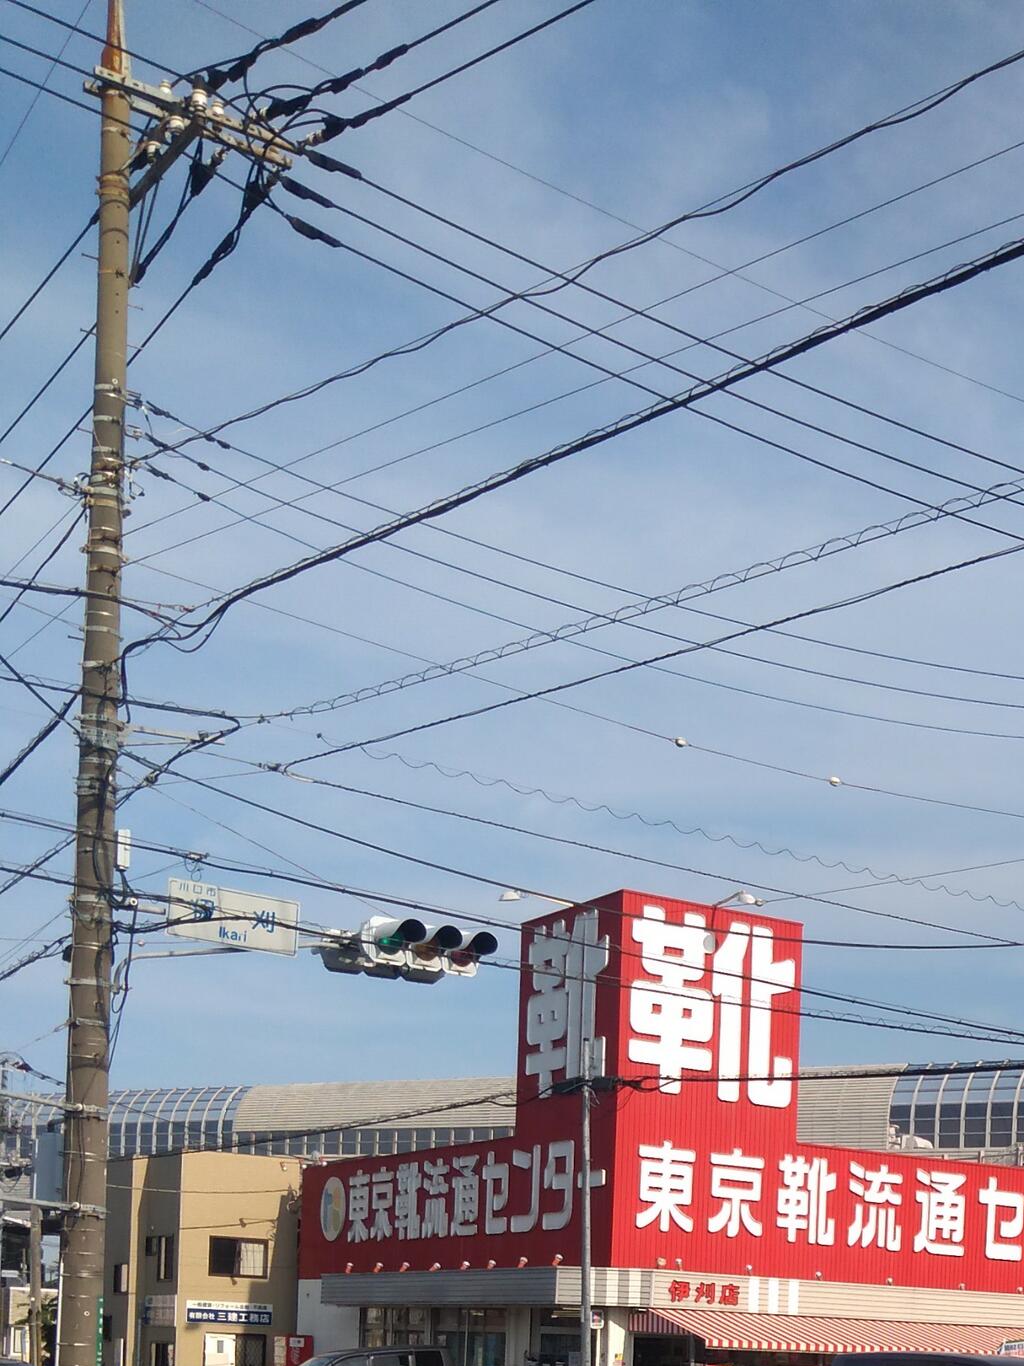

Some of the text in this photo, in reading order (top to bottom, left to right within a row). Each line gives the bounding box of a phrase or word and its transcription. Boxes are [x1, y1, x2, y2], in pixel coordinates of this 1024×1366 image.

[179, 882, 217, 897] 川口市
[218, 926, 247, 942] Ikari
[526, 908, 610, 1100] 靴
[627, 904, 797, 1109] 靴
[347, 1139, 606, 1243] 東京靴流通センター
[667, 1279, 741, 1307] 伊刈店
[216, 1311, 270, 1323] 三建工務店
